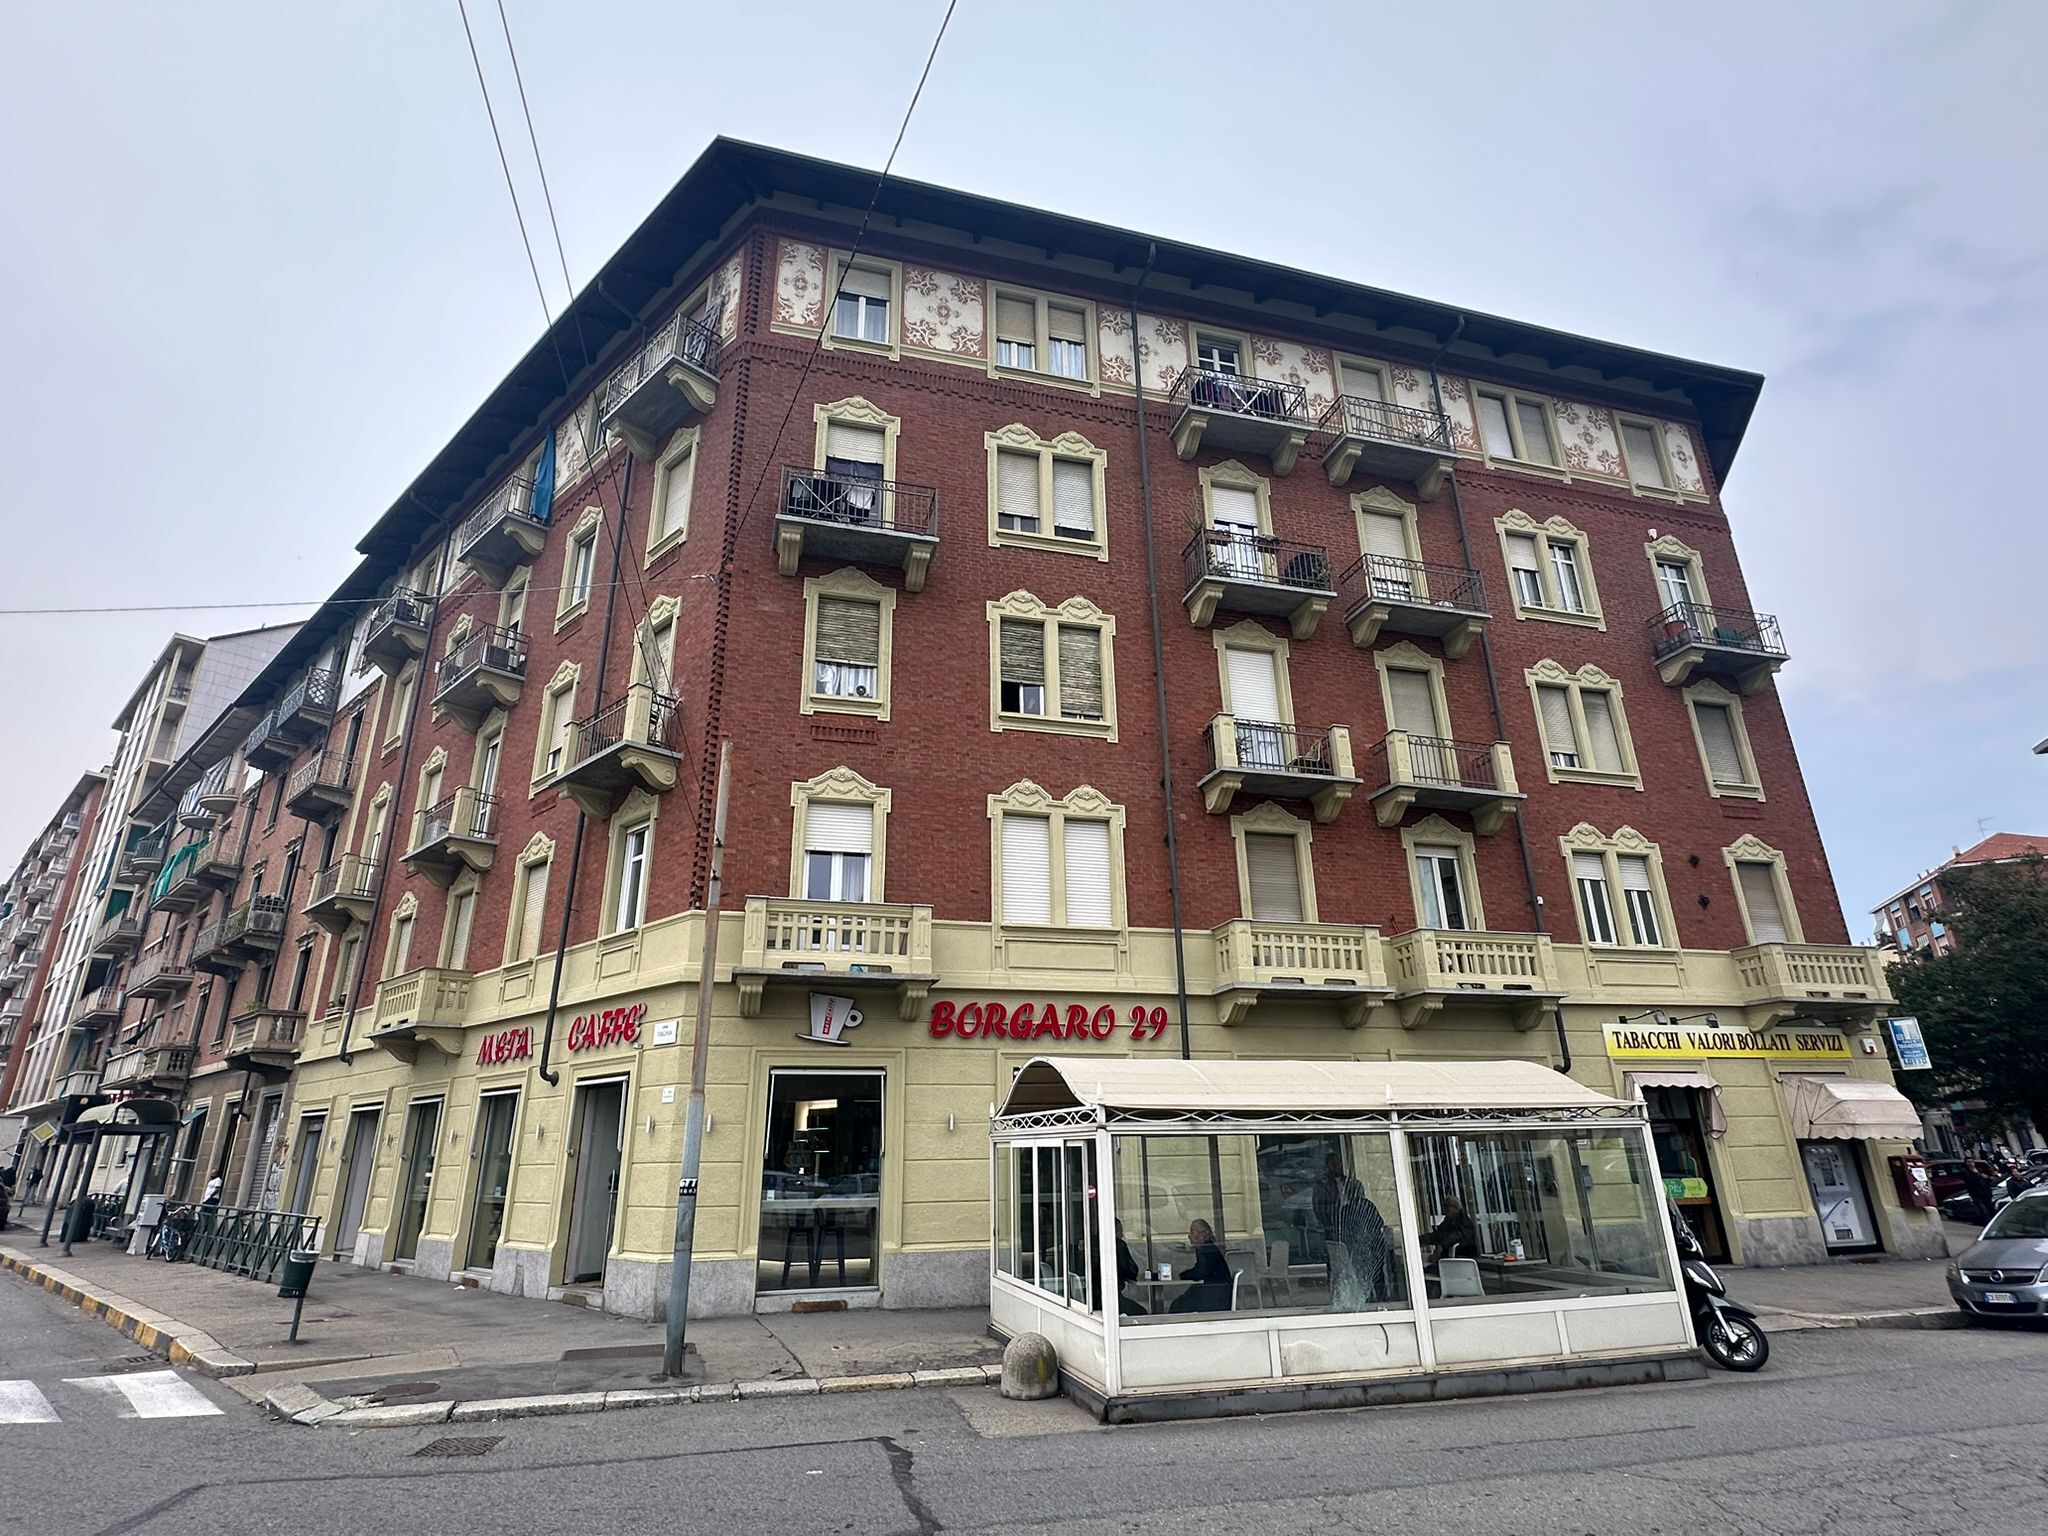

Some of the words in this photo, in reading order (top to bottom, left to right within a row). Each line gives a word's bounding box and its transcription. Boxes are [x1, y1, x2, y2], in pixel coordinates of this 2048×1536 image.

[929, 1000, 1116, 1039] BORGARO
[1130, 1005, 1168, 1040] 29
[476, 1026, 533, 1066] META
[1612, 1031, 1682, 1050] TABACCHI
[1687, 1032, 1736, 1050] VALORI
[1738, 1033, 1791, 1051] BOLLATI
[1796, 1034, 1845, 1052] SERVIZI
